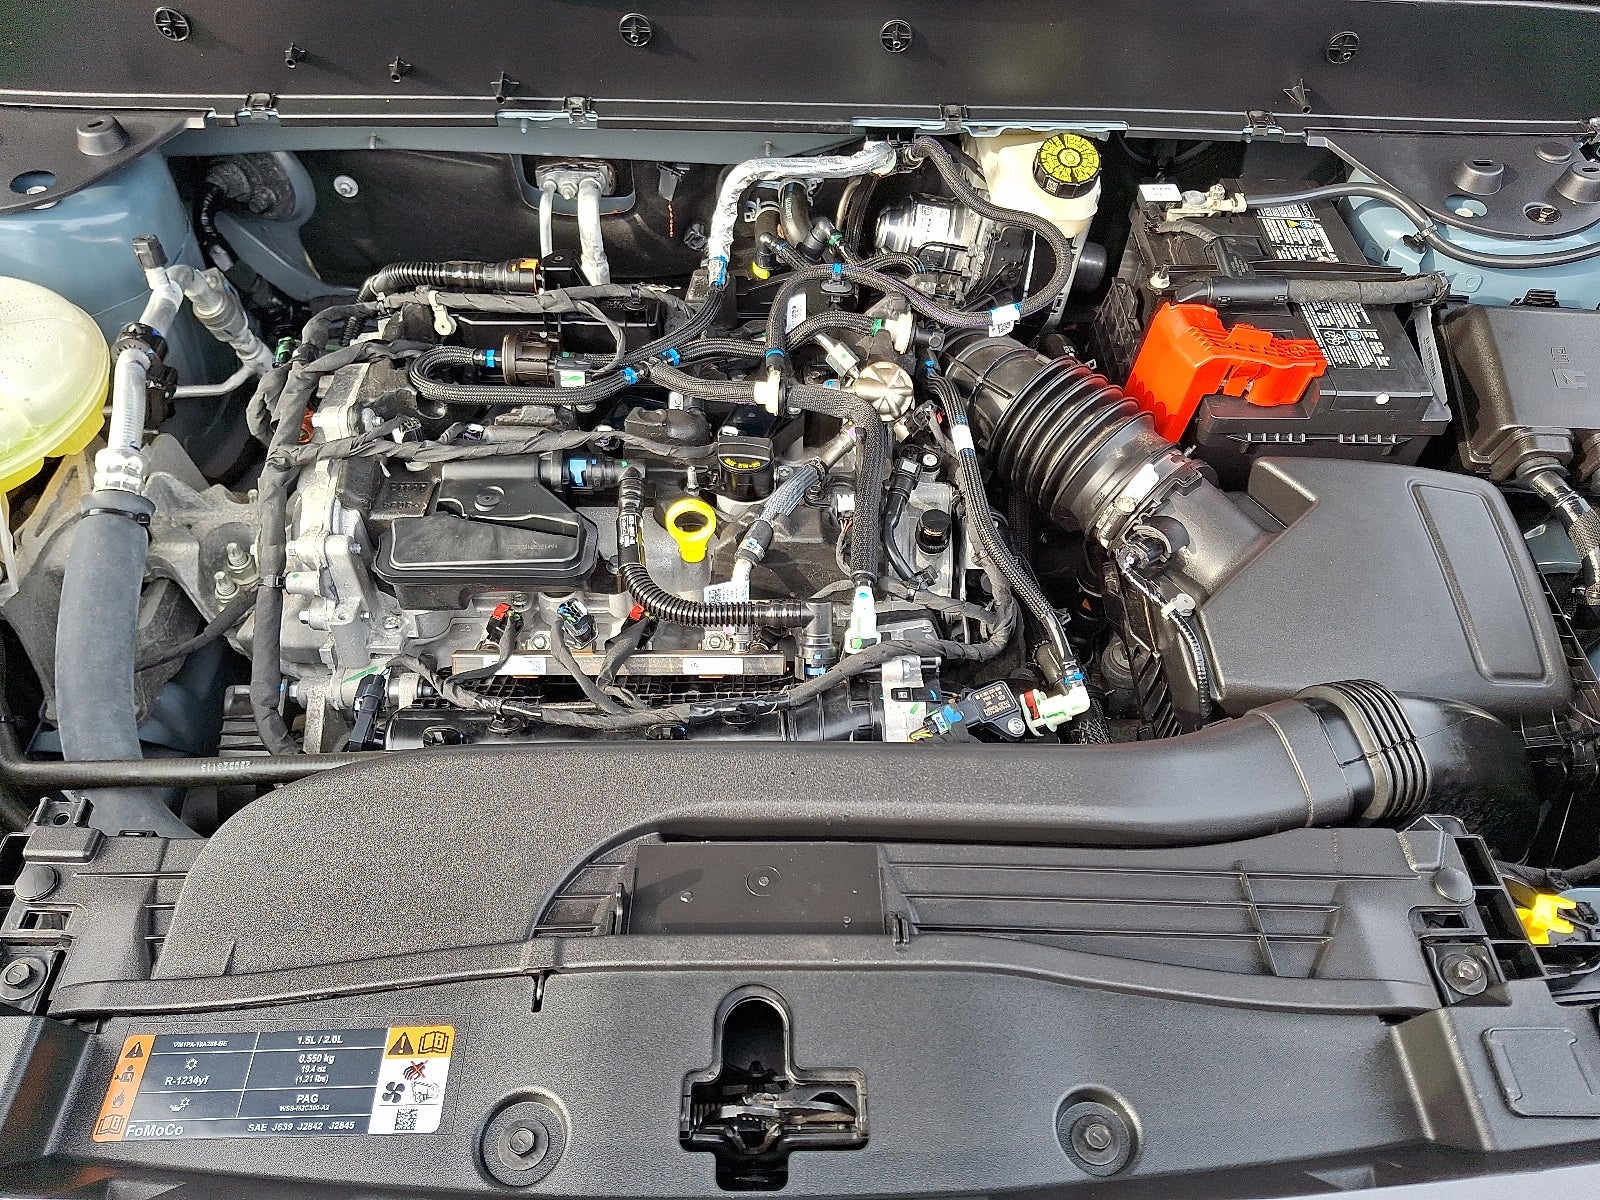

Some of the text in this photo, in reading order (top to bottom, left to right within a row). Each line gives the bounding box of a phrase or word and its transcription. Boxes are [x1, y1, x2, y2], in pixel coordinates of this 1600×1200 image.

[297, 1035, 317, 1045] 1.5L
[323, 1034, 343, 1044] 2.0L
[298, 1053, 335, 1065] 0.550 kg
[301, 1065, 327, 1073] 19.4 oz
[164, 1075, 209, 1087] R-1234yf
[296, 1093, 319, 1104] PAG
[125, 1123, 184, 1137] FoMoCo
[247, 1120, 356, 1132] SAE J639 J2842 J2845
